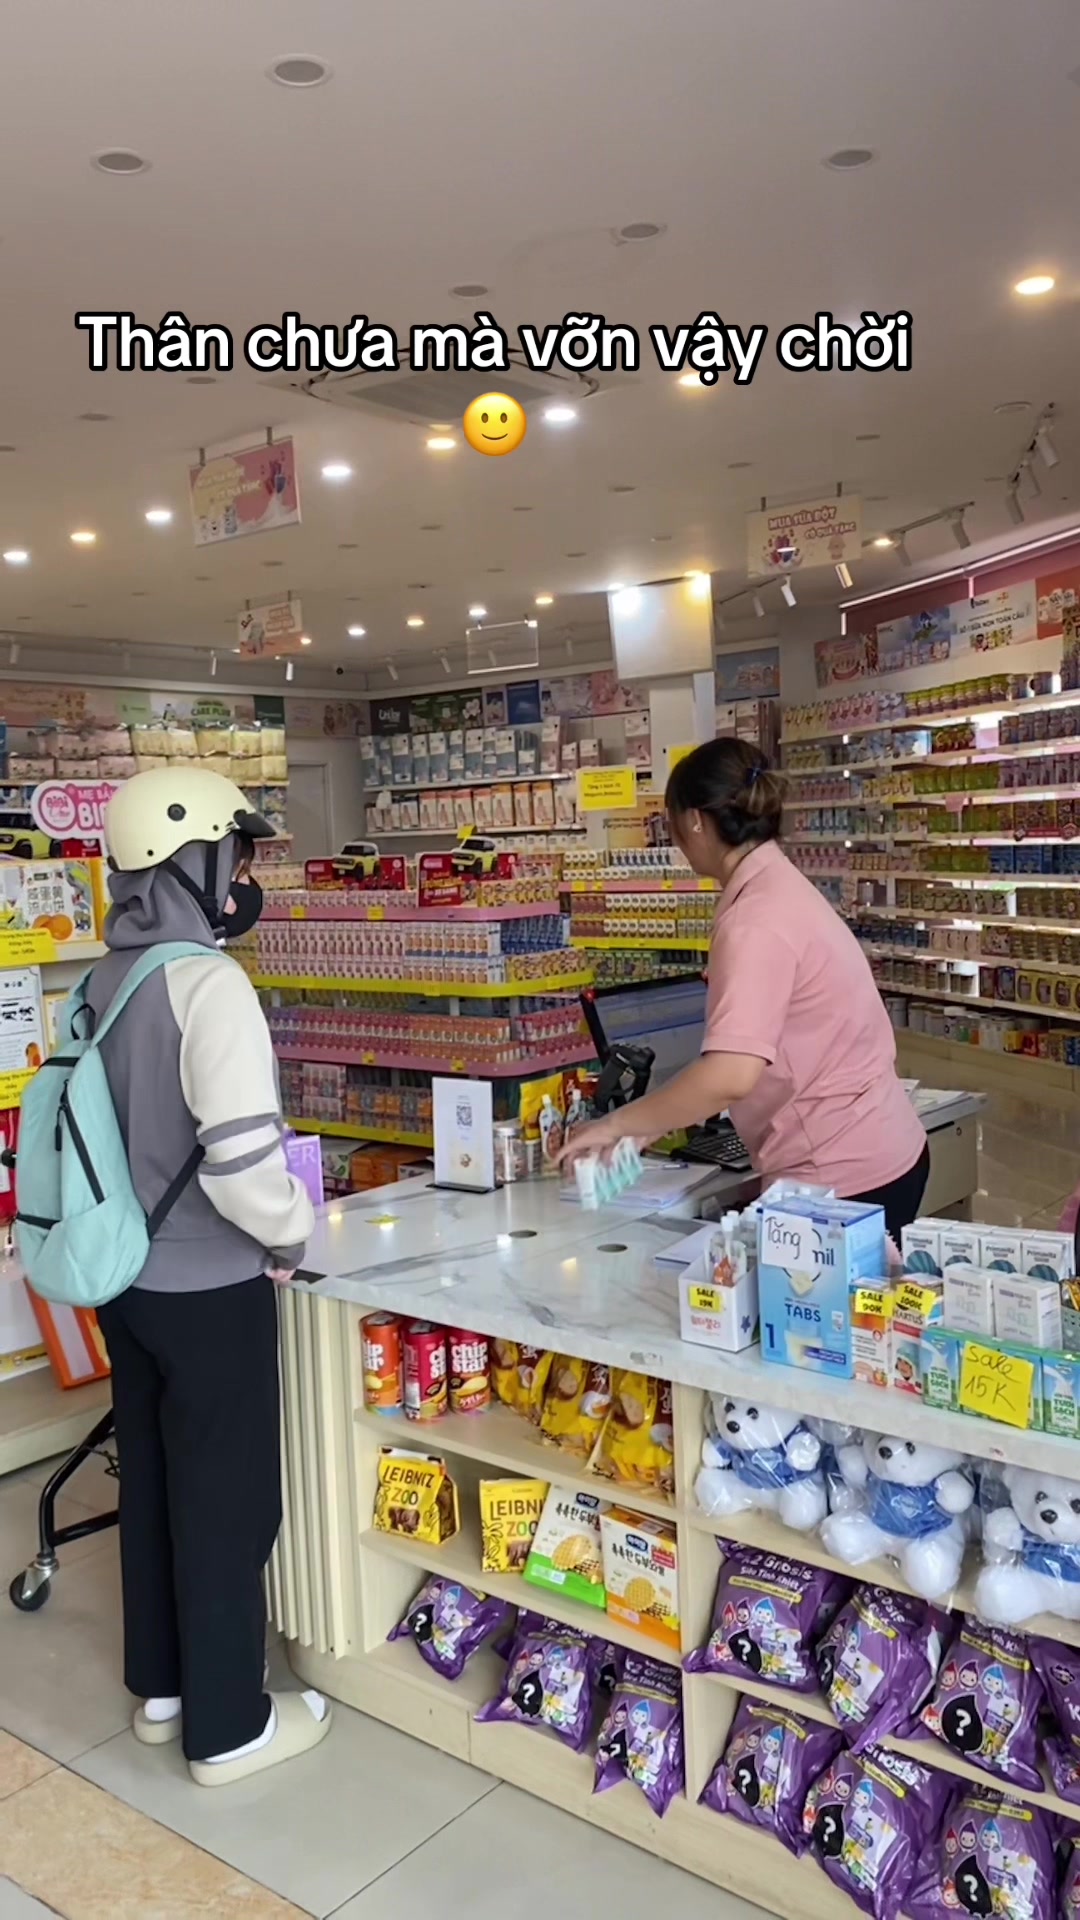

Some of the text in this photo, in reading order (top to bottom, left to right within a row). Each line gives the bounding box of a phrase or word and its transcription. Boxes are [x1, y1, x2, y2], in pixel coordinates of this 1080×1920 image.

[769, 516, 792, 530] MUA
[765, 1216, 802, 1260] Tặng
[1026, 1250, 1057, 1259] Primavita
[696, 1287, 715, 1298] SALE
[860, 1291, 884, 1302] SALE
[903, 1285, 924, 1299] SALE
[784, 1303, 822, 1322] TABS
[862, 1303, 883, 1313] 90K
[765, 1323, 775, 1348] 1
[451, 1356, 488, 1373] star
[966, 1345, 1021, 1384] Sale
[382, 1465, 435, 1489] LEIBNIZ
[391, 1487, 419, 1505] ZOO
